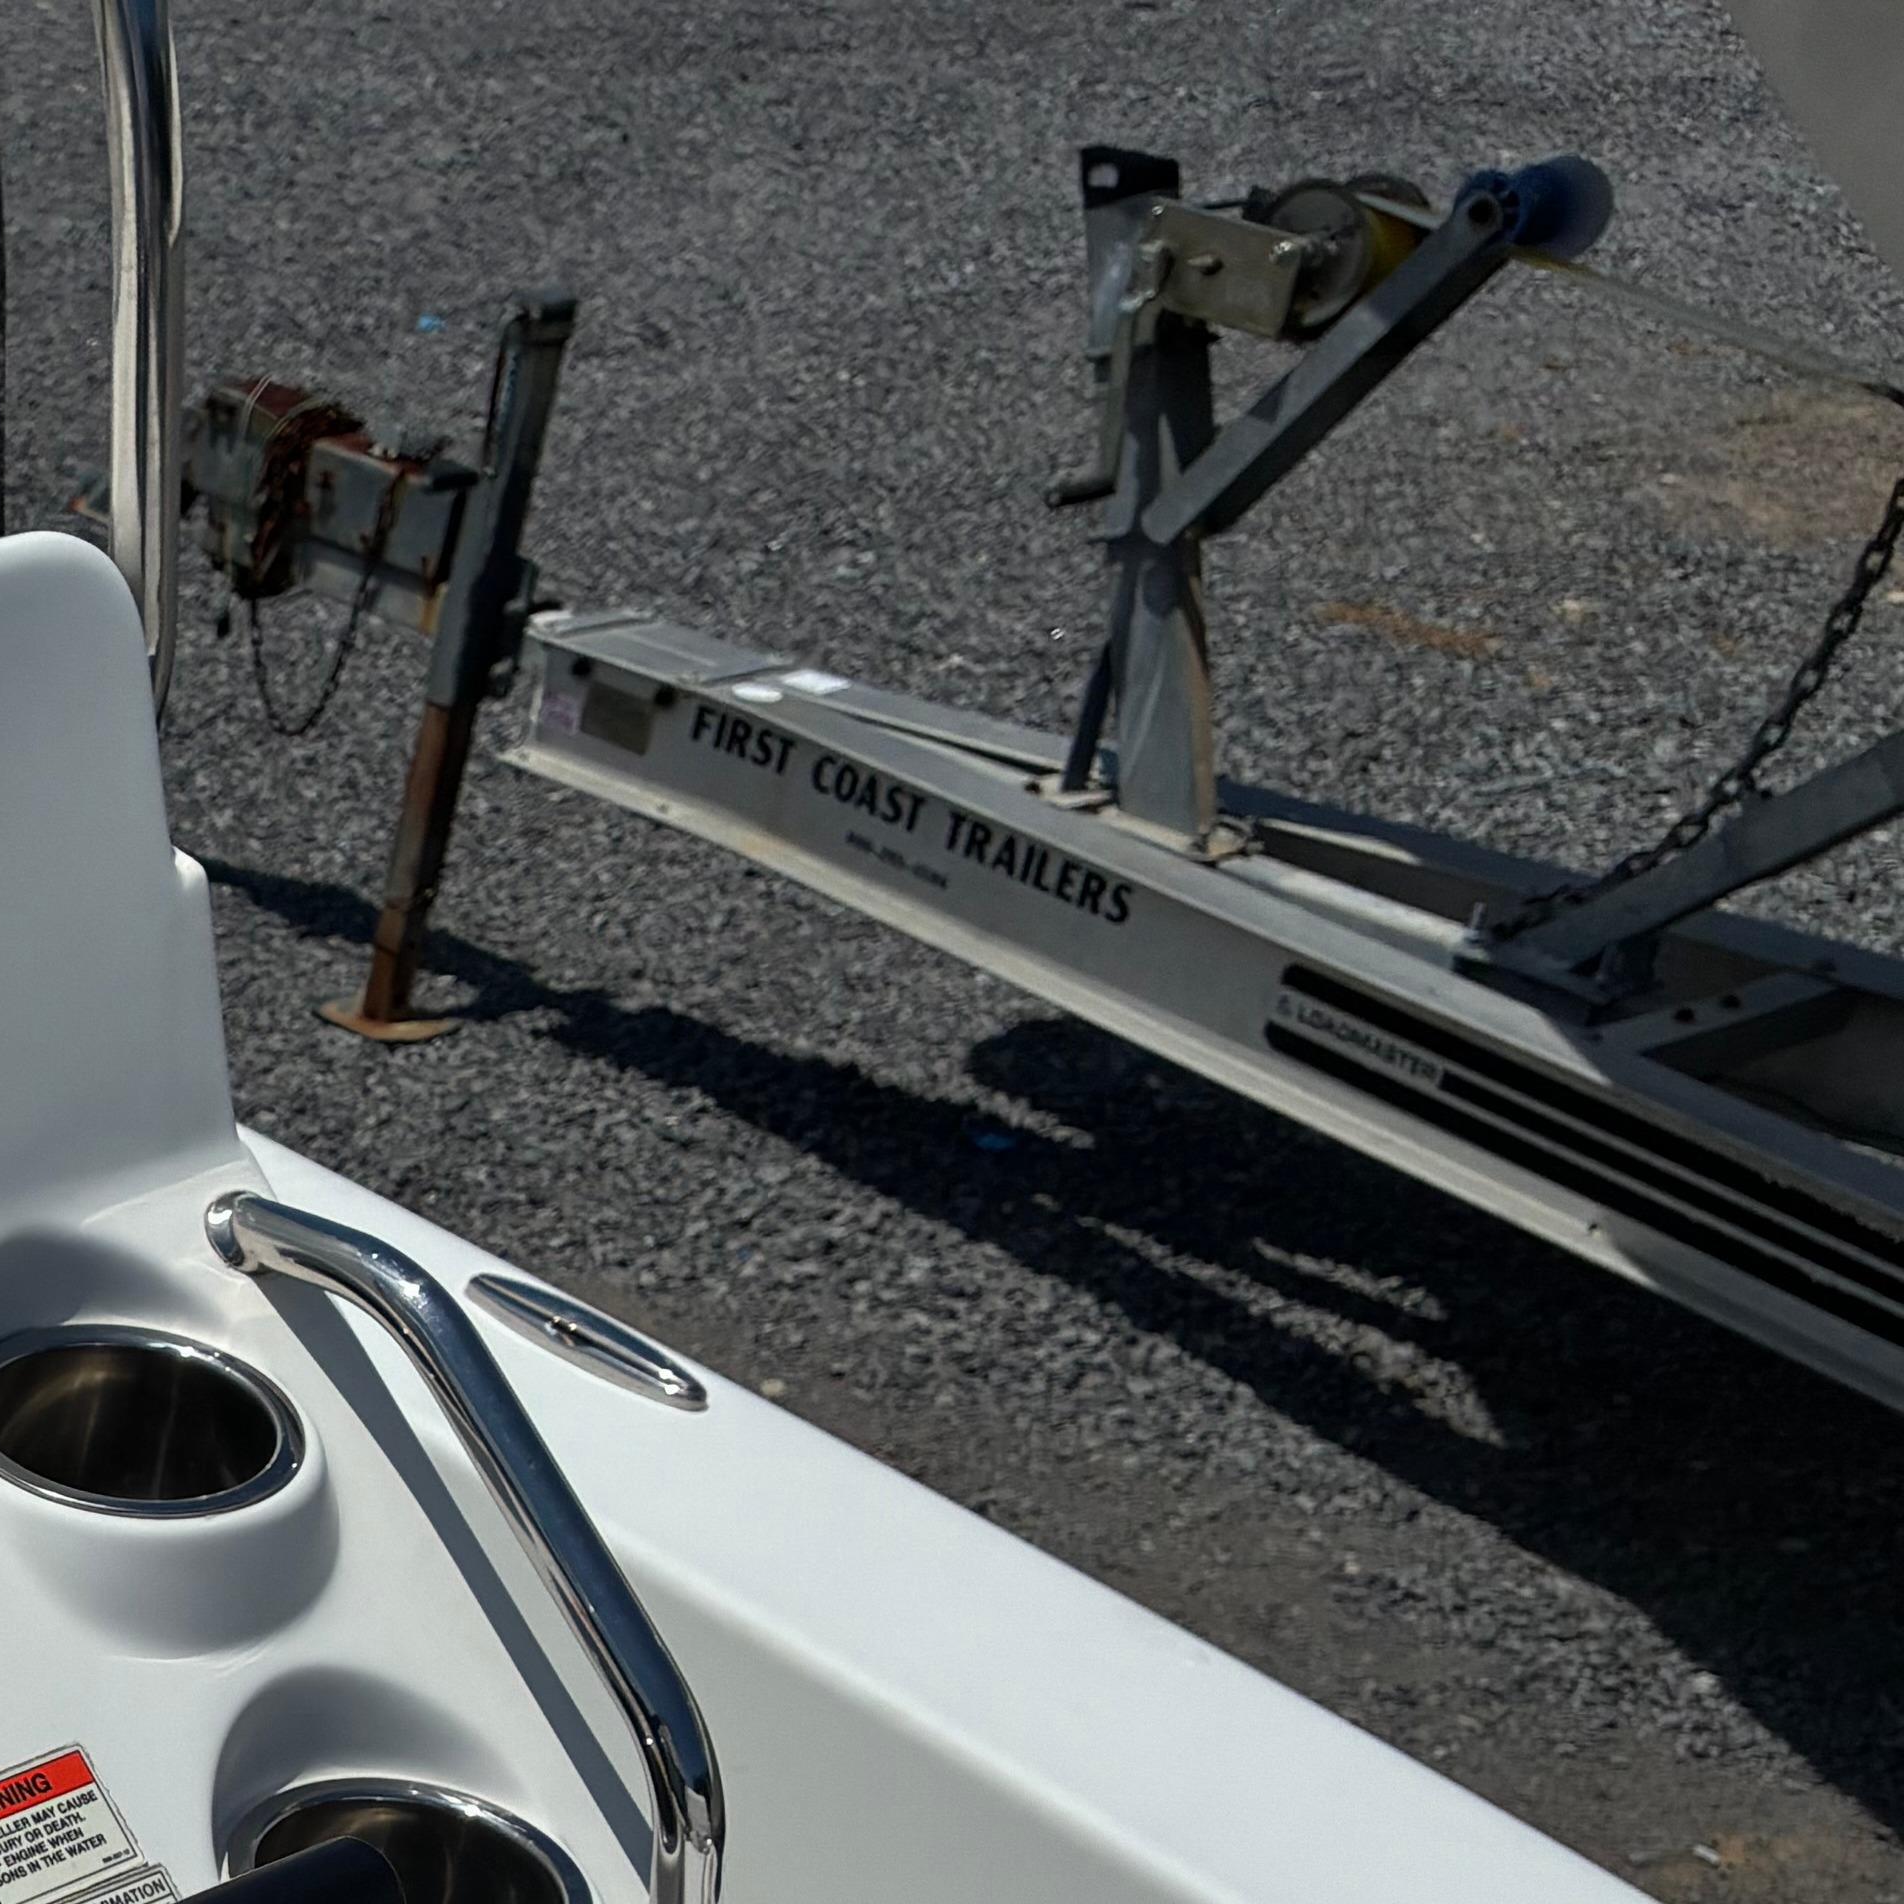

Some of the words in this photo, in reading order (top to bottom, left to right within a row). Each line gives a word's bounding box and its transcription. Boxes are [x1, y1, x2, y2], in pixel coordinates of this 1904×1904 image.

[690, 704, 795, 776] FIRST
[811, 754, 928, 834] COAST
[944, 809, 1132, 925] TRAILERS
[31, 1806, 55, 1824] MAY
[57, 1790, 98, 1814] CAUSE
[3, 1841, 48, 1867] ENGINE
[47, 1827, 84, 1849] WHEN
[24, 1828, 43, 1843] OR
[45, 1812, 86, 1835] DEATH.
[26, 1860, 42, 1874] IN
[40, 1849, 66, 1867] THE
[65, 1833, 107, 1857] WATER
